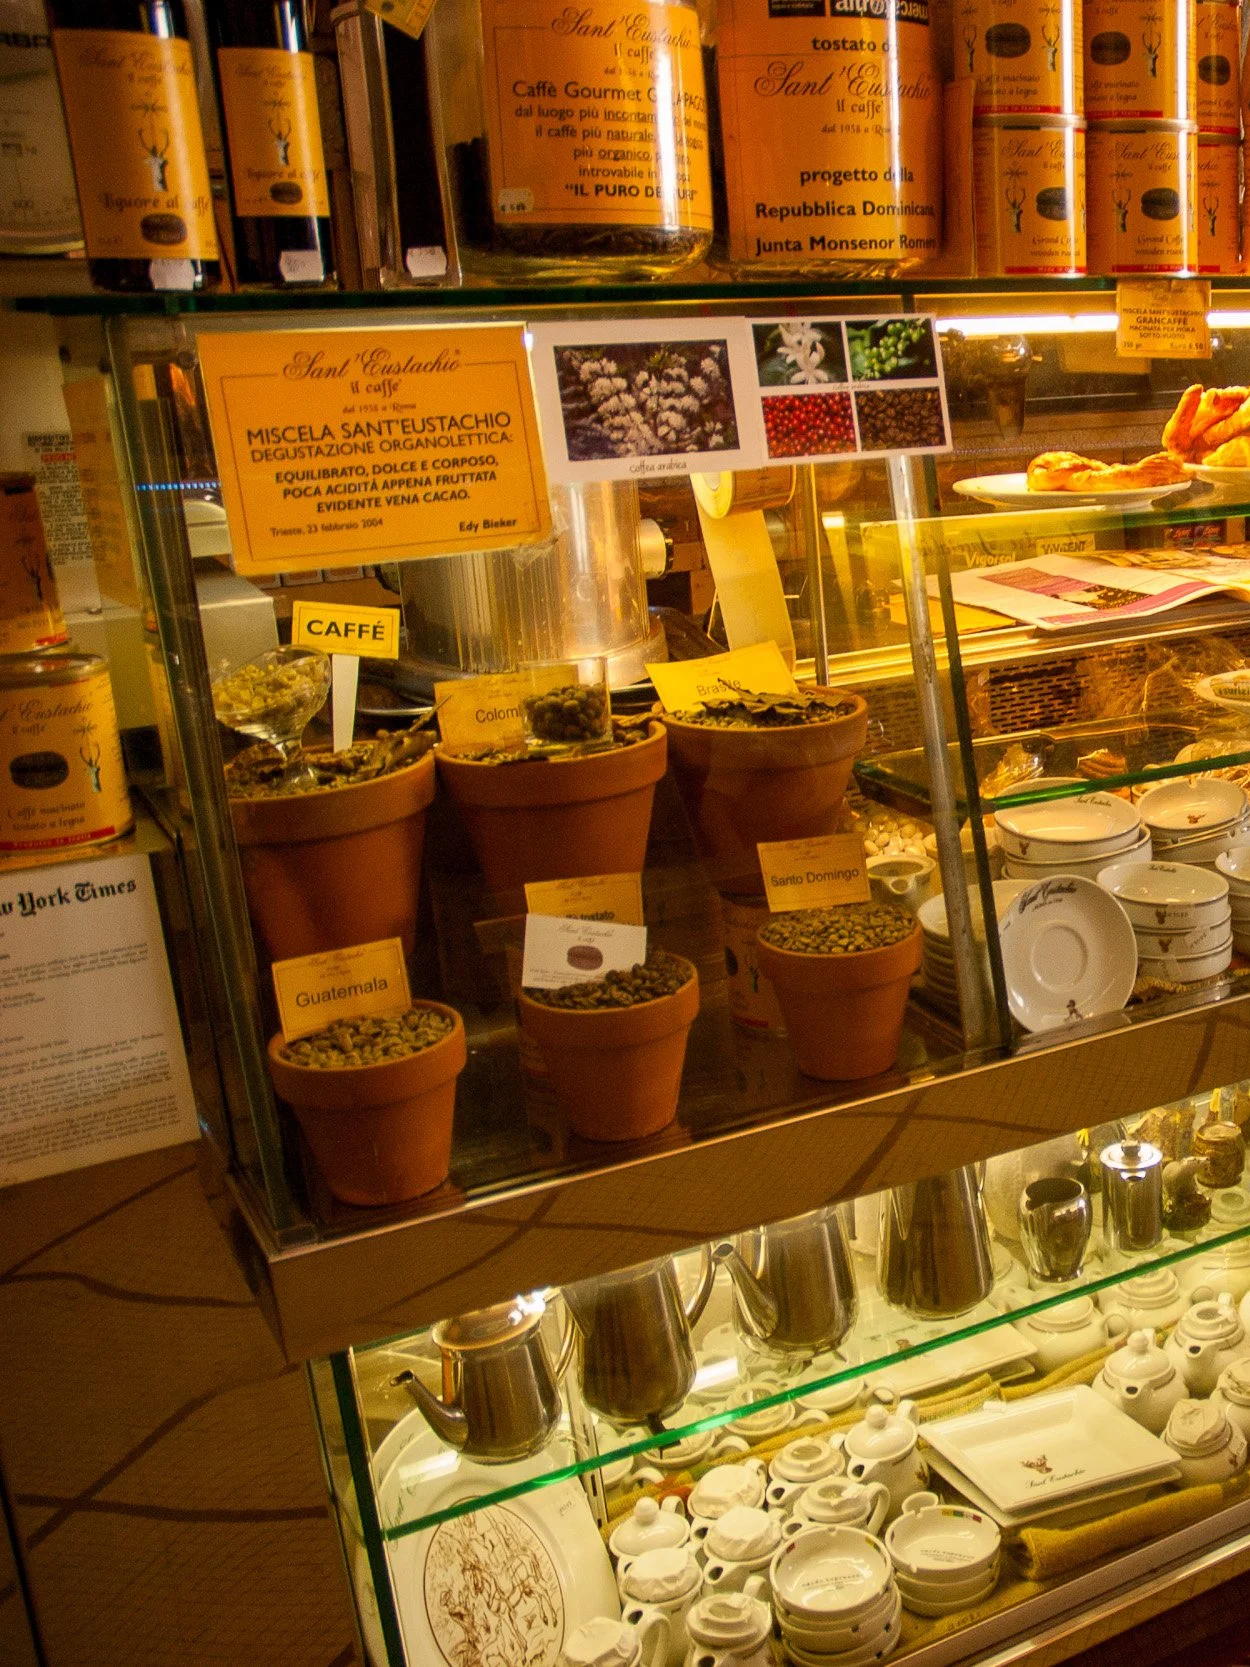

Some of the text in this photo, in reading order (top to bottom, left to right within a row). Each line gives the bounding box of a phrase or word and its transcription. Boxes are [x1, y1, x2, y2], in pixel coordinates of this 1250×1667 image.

[812, 37, 877, 52] tostato
[513, 80, 643, 100] Caffè Gourmet
[515, 105, 599, 122] dal luogo più
[535, 125, 543, 137] il
[547, 125, 577, 138] caffè
[582, 126, 602, 142] più
[573, 148, 593, 161] più
[578, 165, 644, 179] introvabile
[800, 168, 878, 187] progetto
[593, 184, 640, 198] PURO
[755, 201, 856, 223] Repubblica
[755, 234, 895, 257] Junta Monsenor
[247, 410, 512, 446] MISCELA SANT'EUSTACHIO
[251, 431, 514, 463] DEGUSTAZIONE ORGANOLETTICA:
[275, 454, 499, 484] EQUILIBRATO, DOLCE E CORPOSO,
[656, 457, 687, 471] arabica
[283, 485, 322, 499] POCA
[382, 475, 432, 490] APPENA
[435, 470, 497, 484] FRUTTATA
[316, 488, 471, 514] EVIDENTE VENA CACAO.
[362, 518, 384, 529] 2004
[458, 520, 479, 533] Edy
[770, 867, 860, 888] Santo Domingo
[17, 886, 71, 918] York
[74, 879, 137, 903] Times
[295, 977, 389, 1008] Guatemala
